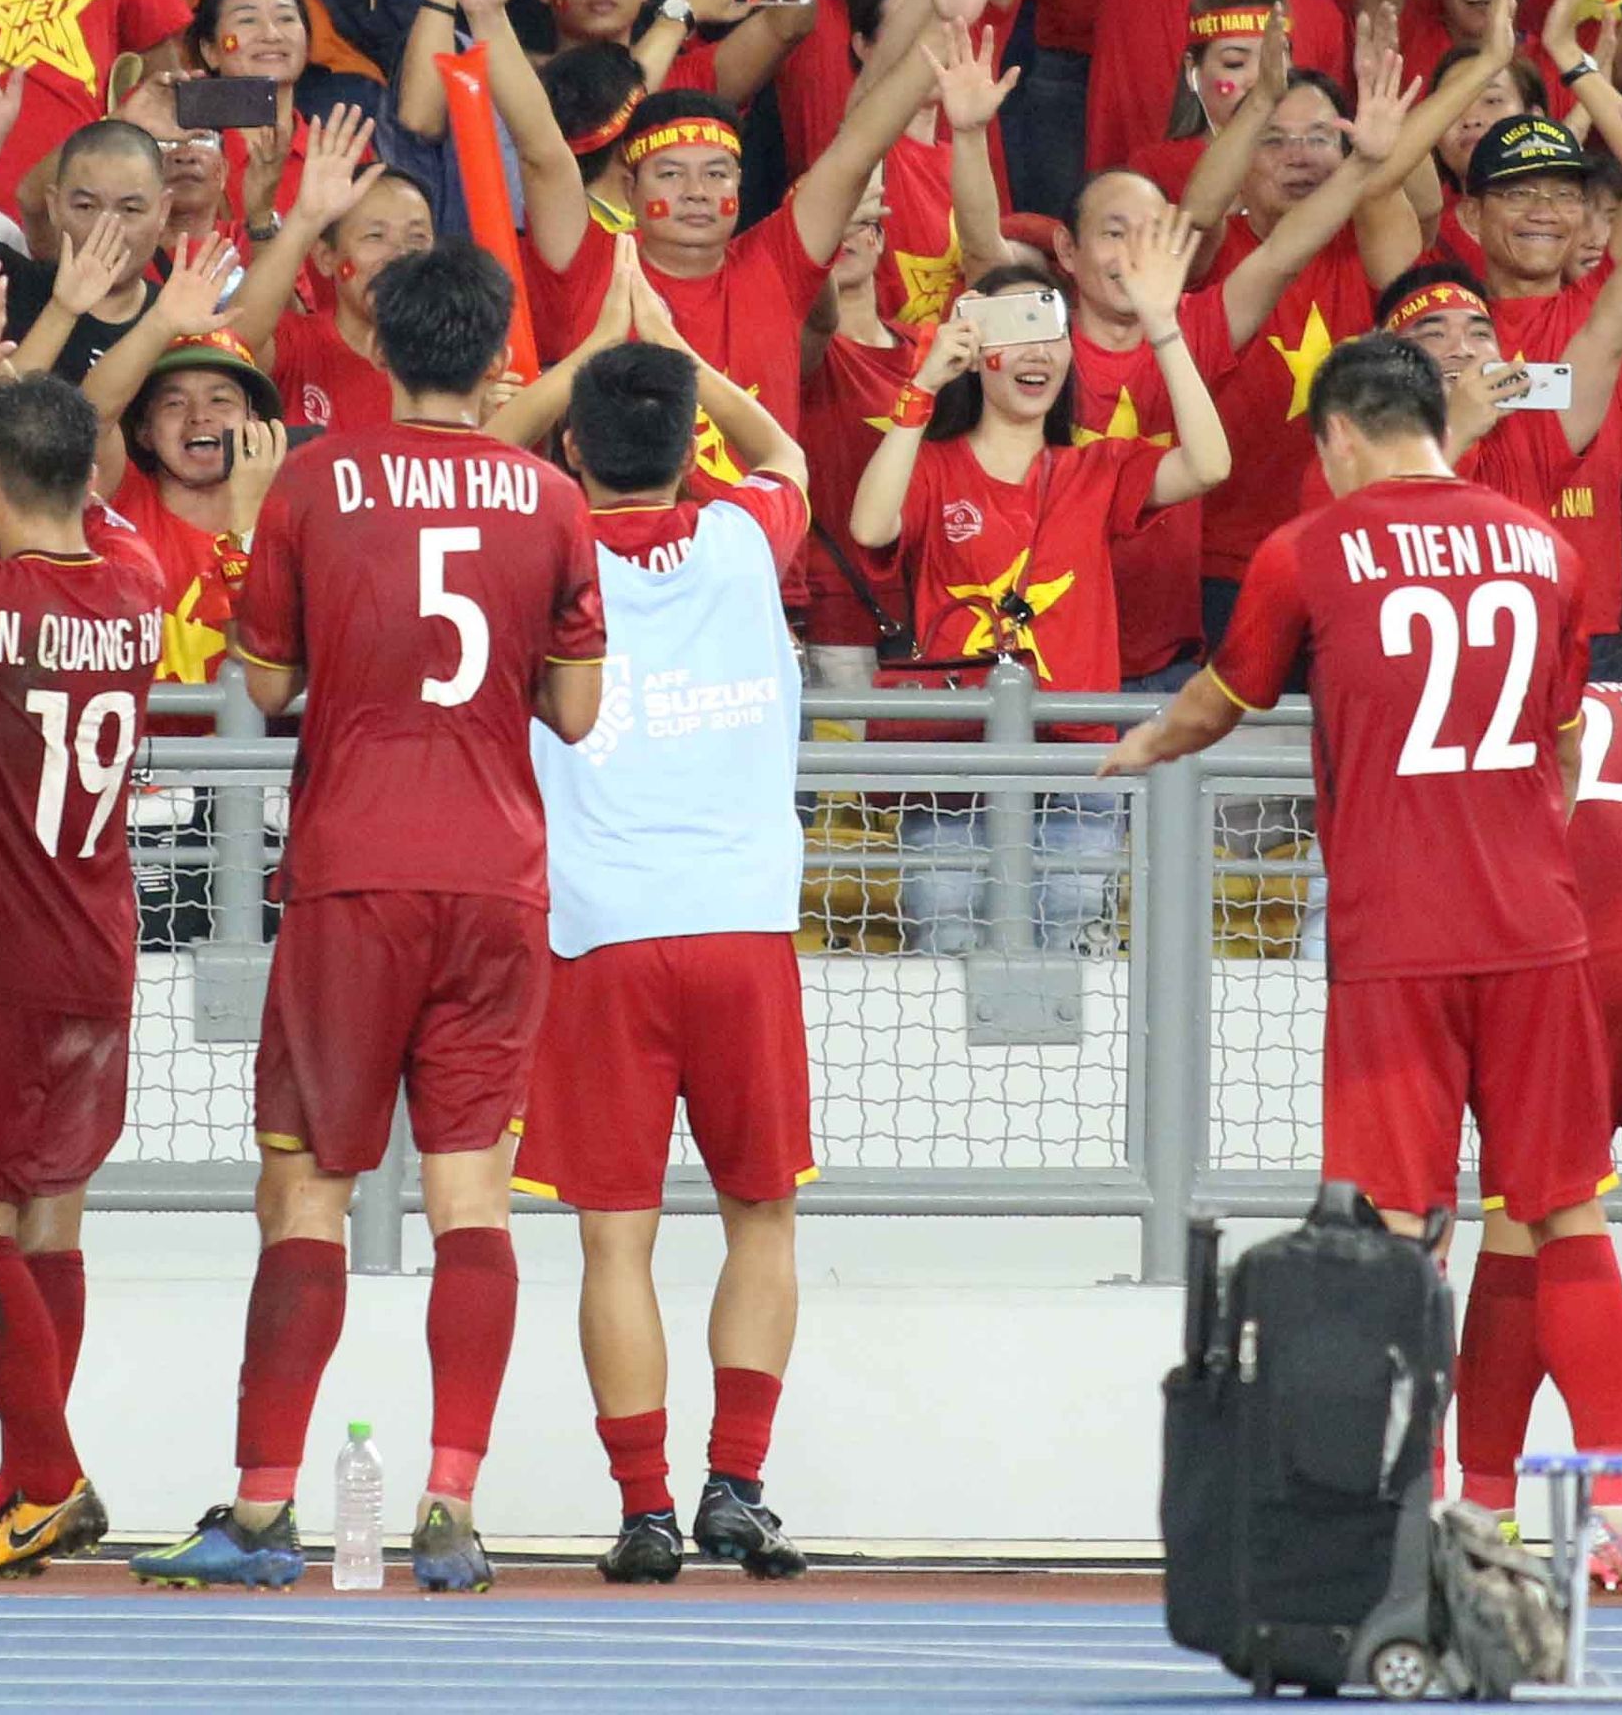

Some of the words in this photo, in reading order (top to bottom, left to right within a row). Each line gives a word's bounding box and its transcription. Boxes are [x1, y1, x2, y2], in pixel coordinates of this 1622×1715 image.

[649, 127, 679, 149] NAM
[1500, 123, 1530, 146] USS
[1533, 121, 1567, 144] IOWA
[334, 458, 375, 514] D.
[382, 453, 458, 510] VAN
[463, 458, 540, 517] HAU
[1341, 532, 1386, 585] N.
[1387, 528, 1484, 580] TIEN
[1486, 523, 1558, 583] LINH
[36, 616, 135, 672] QUANG
[418, 526, 491, 708] 5
[643, 668, 691, 692] AFF
[643, 677, 778, 718] SUZUKI
[1379, 578, 1540, 777] 22
[648, 717, 702, 738] CUP
[24, 688, 138, 858] 19
